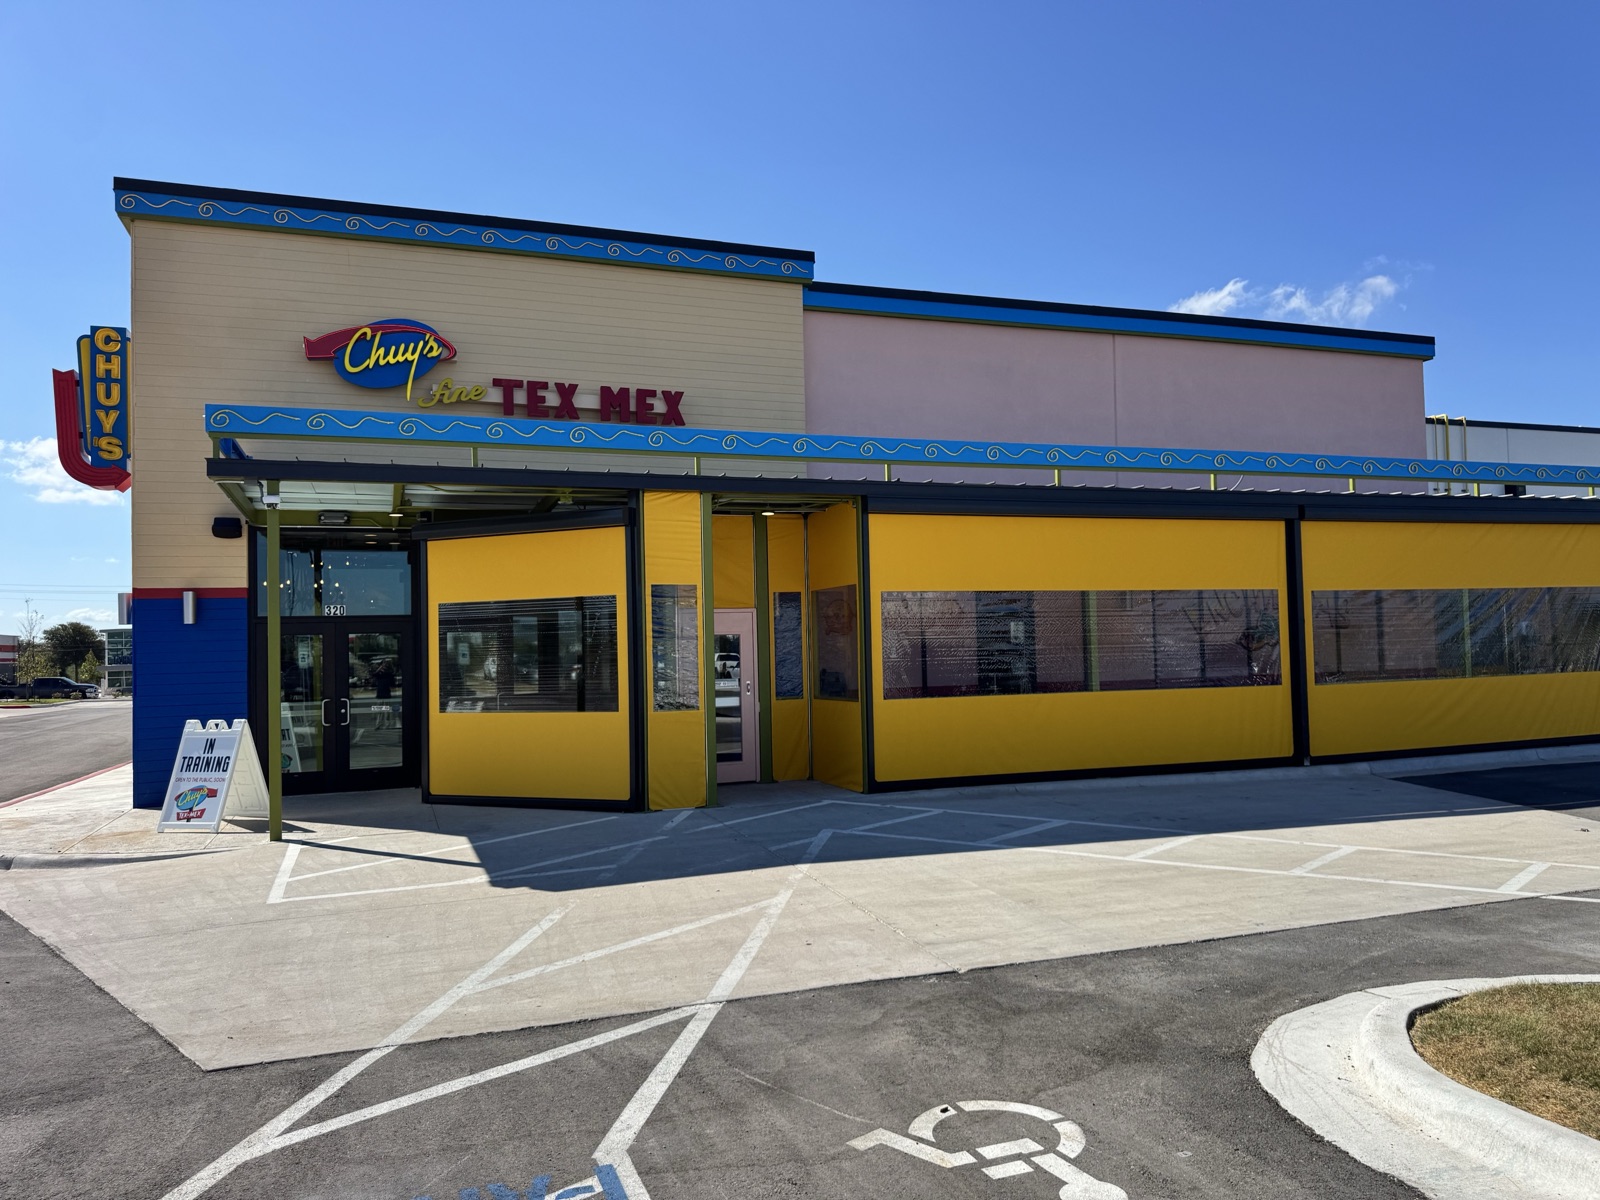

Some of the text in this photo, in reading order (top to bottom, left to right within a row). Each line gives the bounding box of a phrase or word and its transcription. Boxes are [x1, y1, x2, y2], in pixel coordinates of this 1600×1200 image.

[344, 327, 442, 401] Chuy's
[93, 327, 123, 460] CHUY'S
[417, 377, 686, 426] fine TEX MEX
[325, 605, 345, 616] 320
[203, 738, 216, 754] IN
[180, 756, 230, 772] TRAINING
[177, 787, 208, 809] Chuy's
